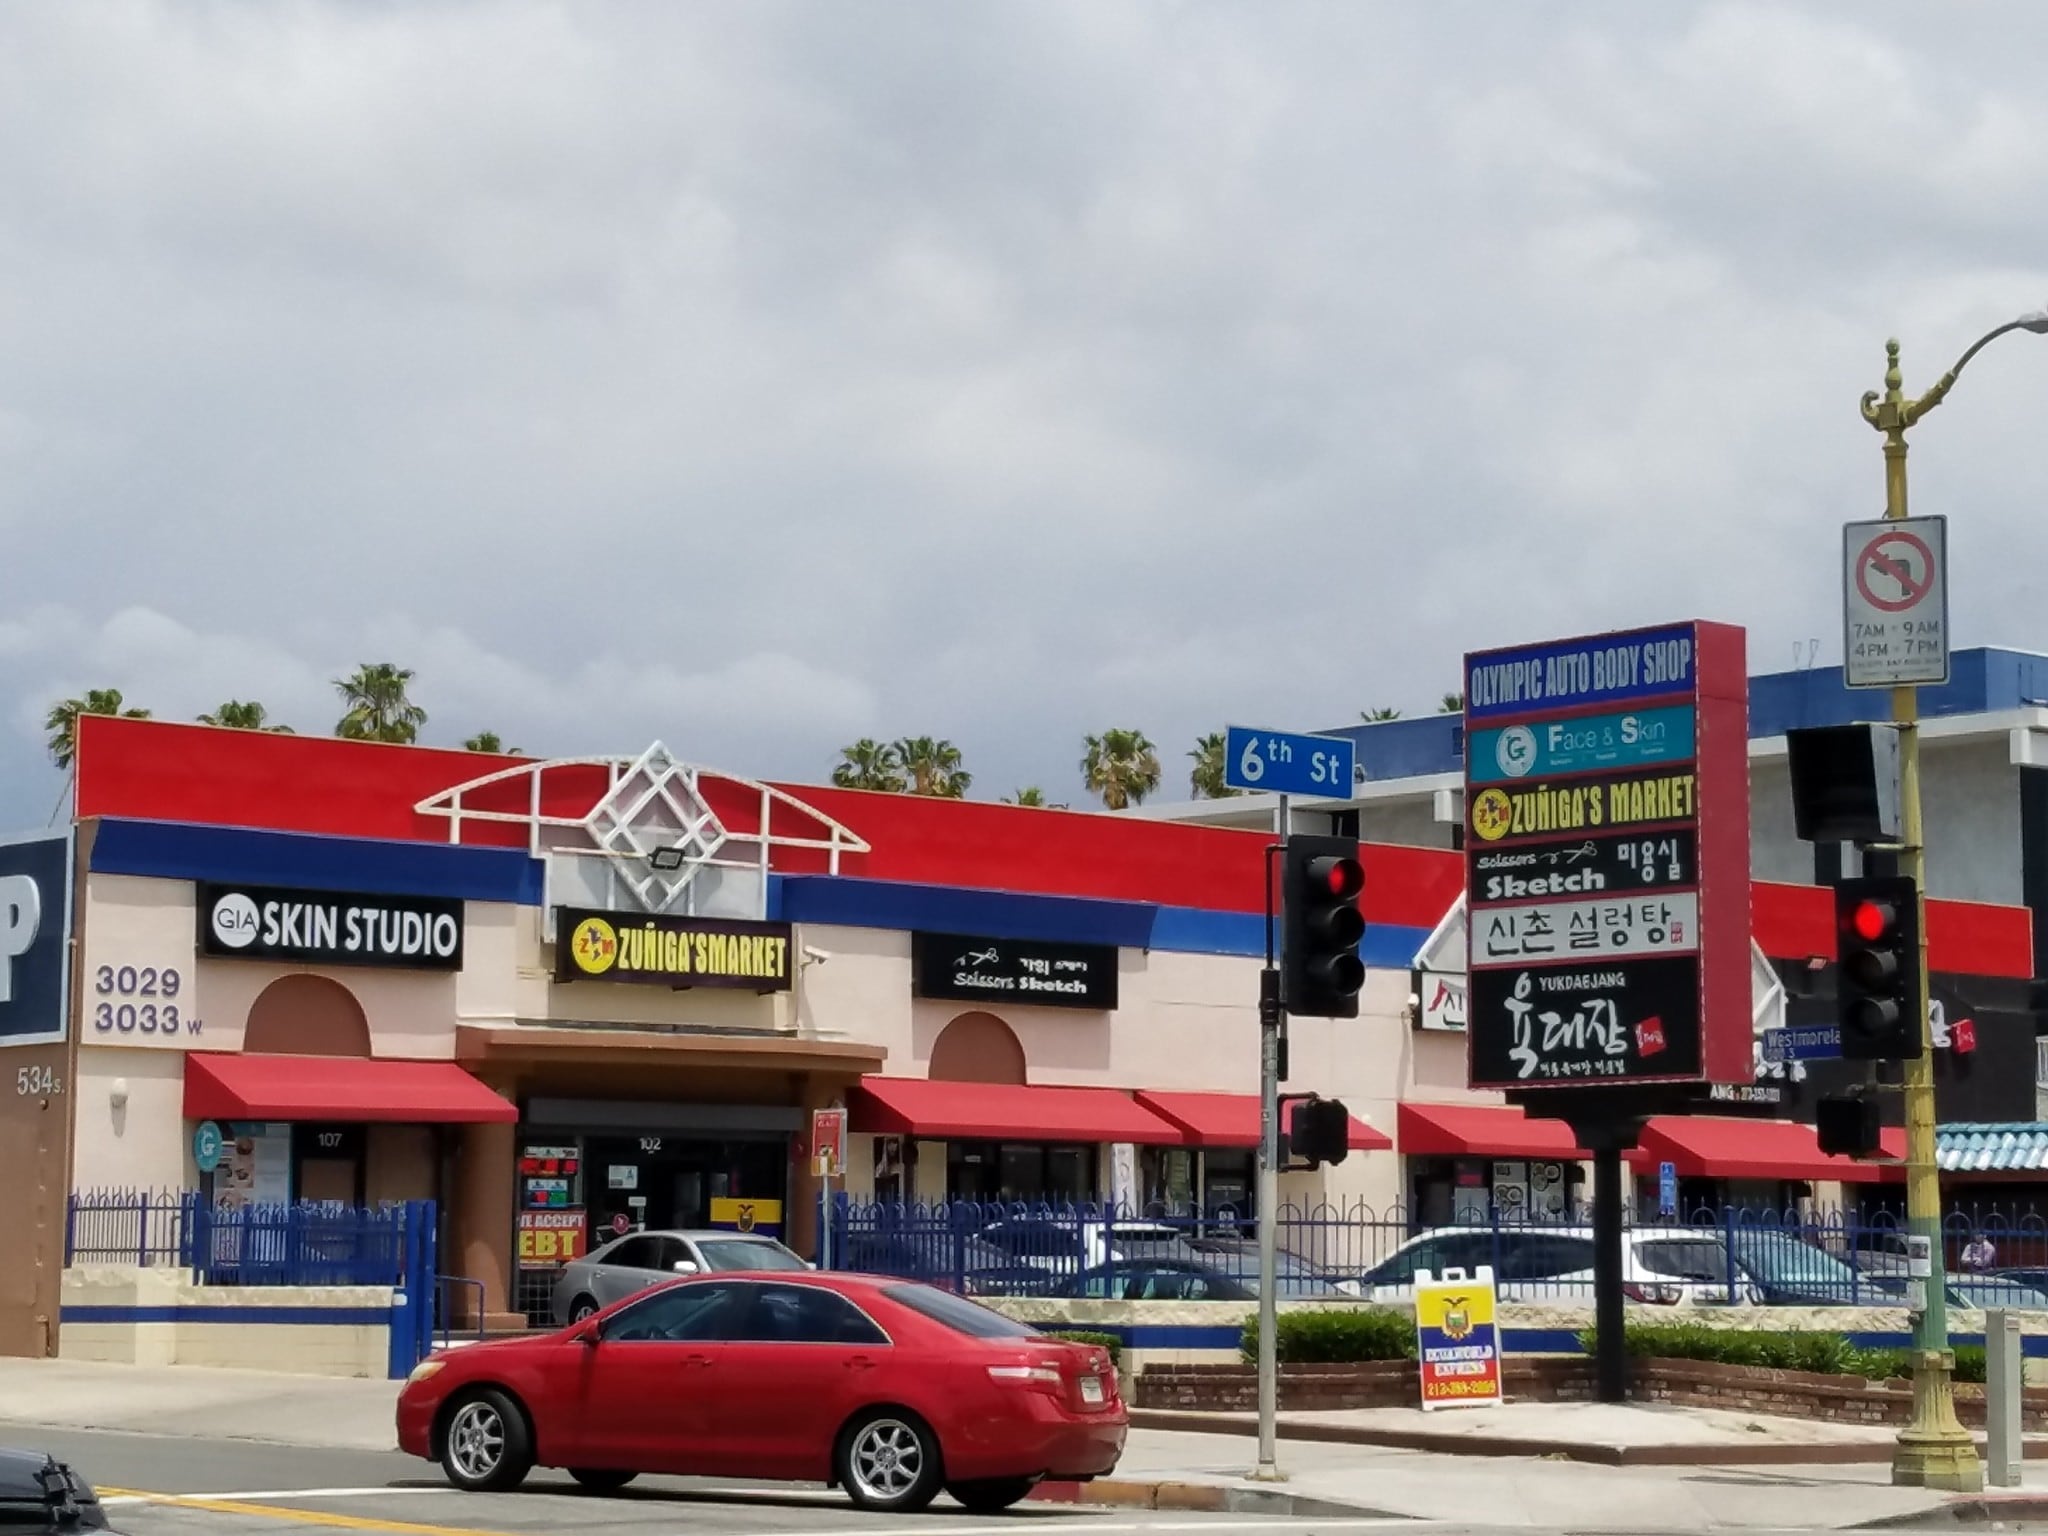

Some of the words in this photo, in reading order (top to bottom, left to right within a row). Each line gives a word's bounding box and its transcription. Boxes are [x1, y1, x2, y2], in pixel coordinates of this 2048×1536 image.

[1472, 658, 1542, 707] OLYMPIC
[1545, 652, 1590, 697] AUTO
[1593, 645, 1641, 690] BODY
[1643, 638, 1691, 685] SHOP
[1548, 725, 1597, 752] Face
[1603, 727, 1613, 746] &
[1621, 716, 1665, 743] Skin
[1241, 737, 1292, 782] 6th
[1310, 751, 1340, 785] St
[1511, 783, 1601, 834] ZUÑIGA'S
[1610, 775, 1694, 824] MARKET
[1617, 838, 1680, 882] 미용실
[1487, 867, 1605, 899] Sketch
[217, 908, 258, 934] GIA
[263, 901, 338, 949] SKIN
[345, 907, 457, 957] STUDIO
[1487, 909, 1555, 956] 신촌
[1569, 902, 1671, 949] 설렁탕
[95, 965, 181, 997] 3029
[1019, 976, 1087, 993] Sketch
[1539, 972, 1627, 991] YUKDAEJANG
[95, 1002, 180, 1033] 3033
[318, 1133, 342, 1147] 107
[640, 1138, 661, 1150] 102
[535, 1214, 584, 1227] ACCEPT
[520, 1231, 579, 1257] EBT
